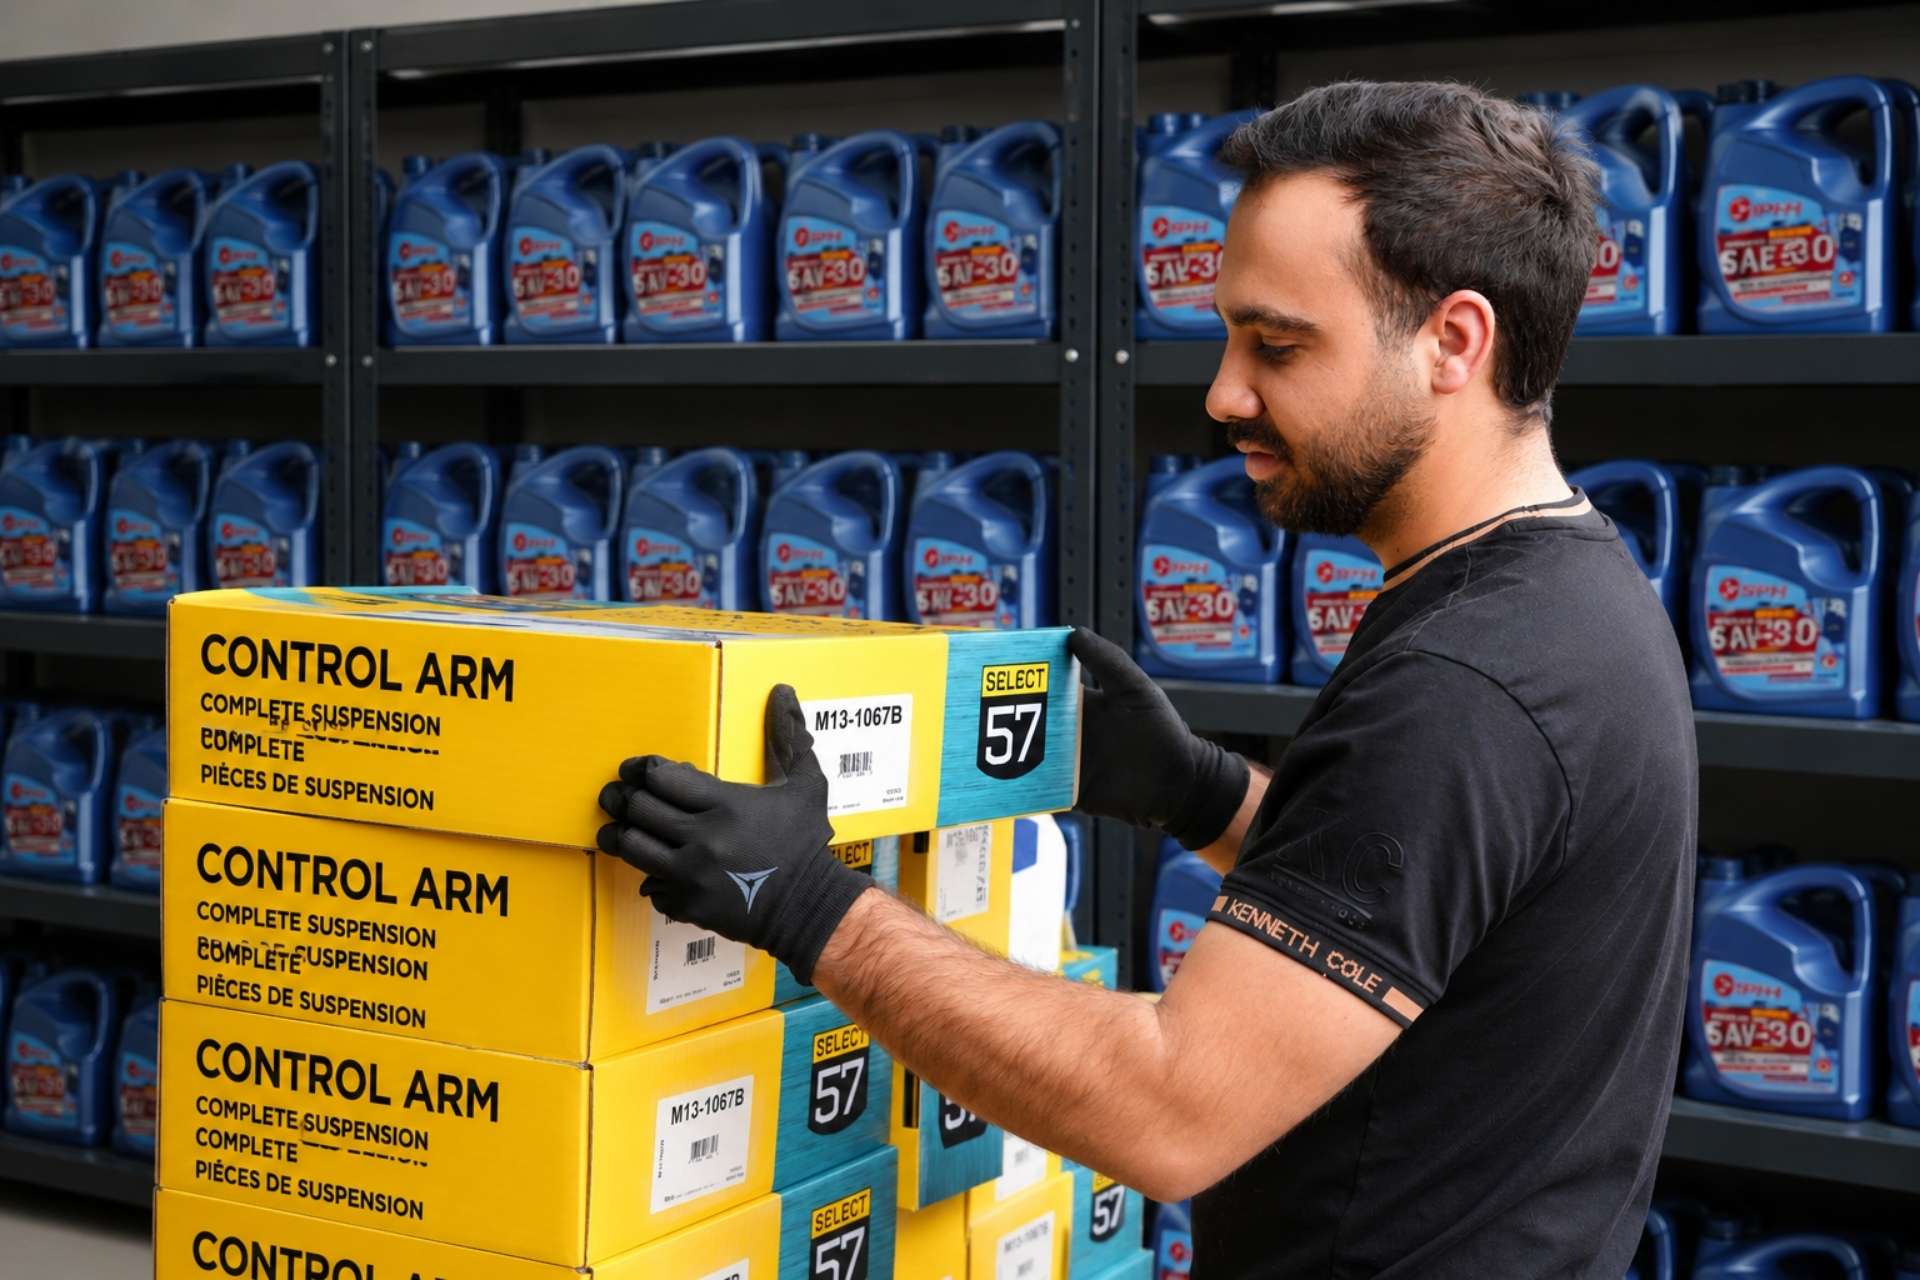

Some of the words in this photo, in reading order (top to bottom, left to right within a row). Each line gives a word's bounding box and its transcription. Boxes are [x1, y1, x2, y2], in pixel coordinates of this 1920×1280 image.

[201, 633, 402, 693] CONTROL
[415, 650, 515, 703] ARM
[985, 667, 1045, 692] SELECT
[200, 691, 305, 723] COMPLETE
[311, 702, 441, 738] SUSPENSION
[815, 704, 902, 731] M13-1067B
[985, 703, 1043, 766] 57
[272, 771, 299, 796] DE
[304, 775, 434, 811] SUSPENSION
[196, 842, 398, 906] CONTROL
[410, 865, 510, 918] ARM
[196, 900, 301, 933] COMPLETE
[307, 912, 437, 950] SUSPENSION
[1227, 898, 1320, 959] KENNETH
[1325, 950, 1383, 994] COLE
[267, 985, 293, 1008] DE
[299, 990, 427, 1030] SUSPENSION
[815, 1026, 866, 1058] SELECT
[196, 1038, 392, 1107] CONTROL
[403, 1069, 500, 1123] ARM
[814, 1057, 865, 1125] 57
[195, 1094, 298, 1130] COMPLETE
[303, 1112, 429, 1152] SUSPENSION
[670, 1087, 745, 1126] M13-1067B
[195, 1126, 298, 1164] COMPLETE
[265, 1172, 292, 1196] DE
[297, 1177, 424, 1221] SUSPENSION
[814, 1193, 868, 1233] SELECT
[1091, 1185, 1125, 1237] 57
[814, 1225, 866, 1280] 57
